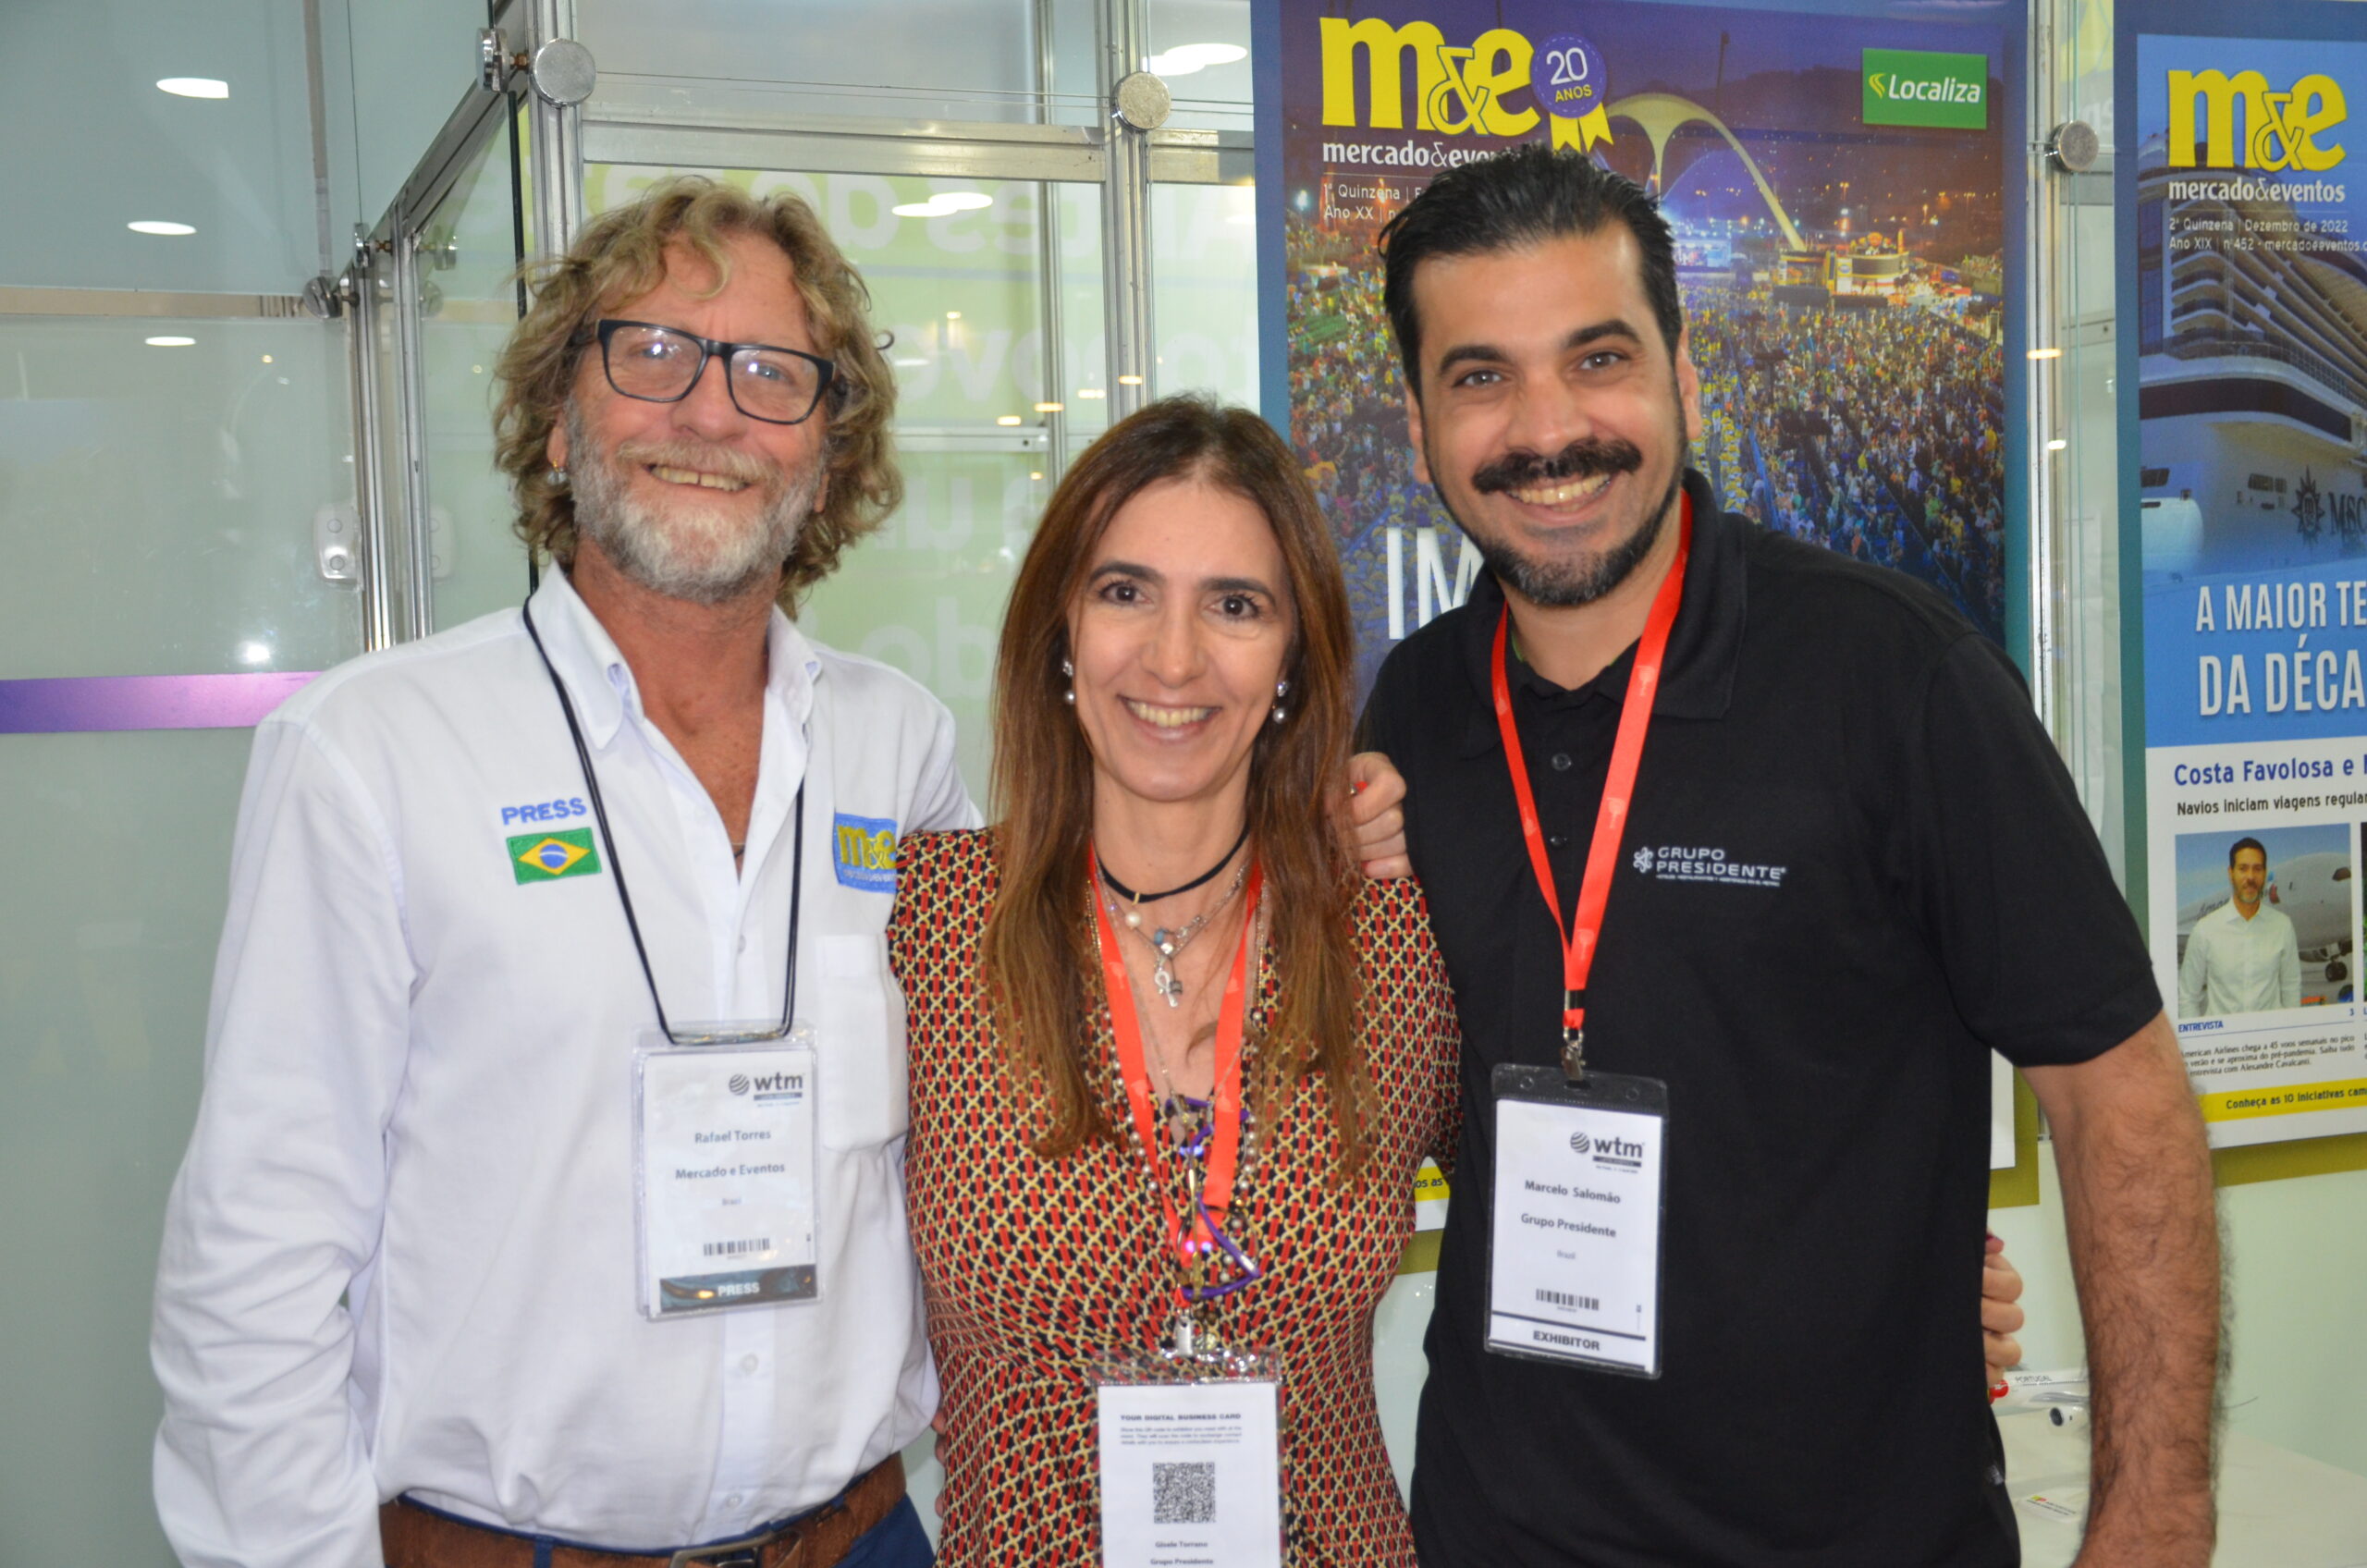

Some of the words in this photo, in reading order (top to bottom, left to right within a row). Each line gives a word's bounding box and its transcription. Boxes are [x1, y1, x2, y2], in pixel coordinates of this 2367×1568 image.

[1319, 17, 1540, 136] m&e
[1546, 47, 1588, 85] 20
[1554, 84, 1593, 104] ANOS
[1889, 74, 1981, 104] Localiza
[2167, 68, 2348, 172] m&e
[1338, 184, 1401, 201] Quinzena
[2168, 176, 2346, 202] mercado&eventos
[1325, 204, 1351, 220] Ano
[1355, 206, 1374, 220] XX
[2183, 218, 2234, 232] Quinzena
[2245, 218, 2300, 233] Dezembro
[2303, 221, 2317, 233] de
[2321, 219, 2349, 233] 2022
[2169, 237, 2190, 250] Ano
[2194, 238, 2212, 250] XIX
[2195, 586, 2215, 631] A
[2226, 582, 2327, 631] MAIOR
[2200, 654, 2251, 717] DA
[2265, 633, 2366, 713] DÉCA
[2174, 763, 2234, 786] Costa
[2243, 758, 2334, 782] Favolosa
[2342, 758, 2354, 776] e
[500, 797, 587, 826] PRESS
[2177, 799, 2220, 816] Navios
[2224, 797, 2269, 813] iniciam
[2274, 795, 2321, 812] viagens
[1657, 846, 1726, 862] GRUPO
[1656, 860, 1781, 881] PRESIDENTE
[2177, 1020, 2224, 1033] ENTREVISTA
[754, 1072, 803, 1091] wtm
[2226, 1097, 2267, 1109] Conheça
[2271, 1096, 2281, 1105] as
[2284, 1094, 2294, 1103] 10
[2298, 1089, 2345, 1103] iniciativas
[694, 1131, 731, 1145] Rafael
[734, 1130, 771, 1143] Torres
[1594, 1136, 1642, 1158] wtm
[675, 1167, 727, 1180] Mercado
[730, 1167, 737, 1176] e
[740, 1163, 785, 1176] Eventos
[1525, 1180, 1568, 1196] Marcelo
[1573, 1187, 1621, 1204] Salomão
[1521, 1213, 1555, 1230] Grupo
[1557, 1218, 1616, 1238] Presidente
[717, 1281, 761, 1297] PRESS
[1533, 1330, 1600, 1351] EXHIBITOR
